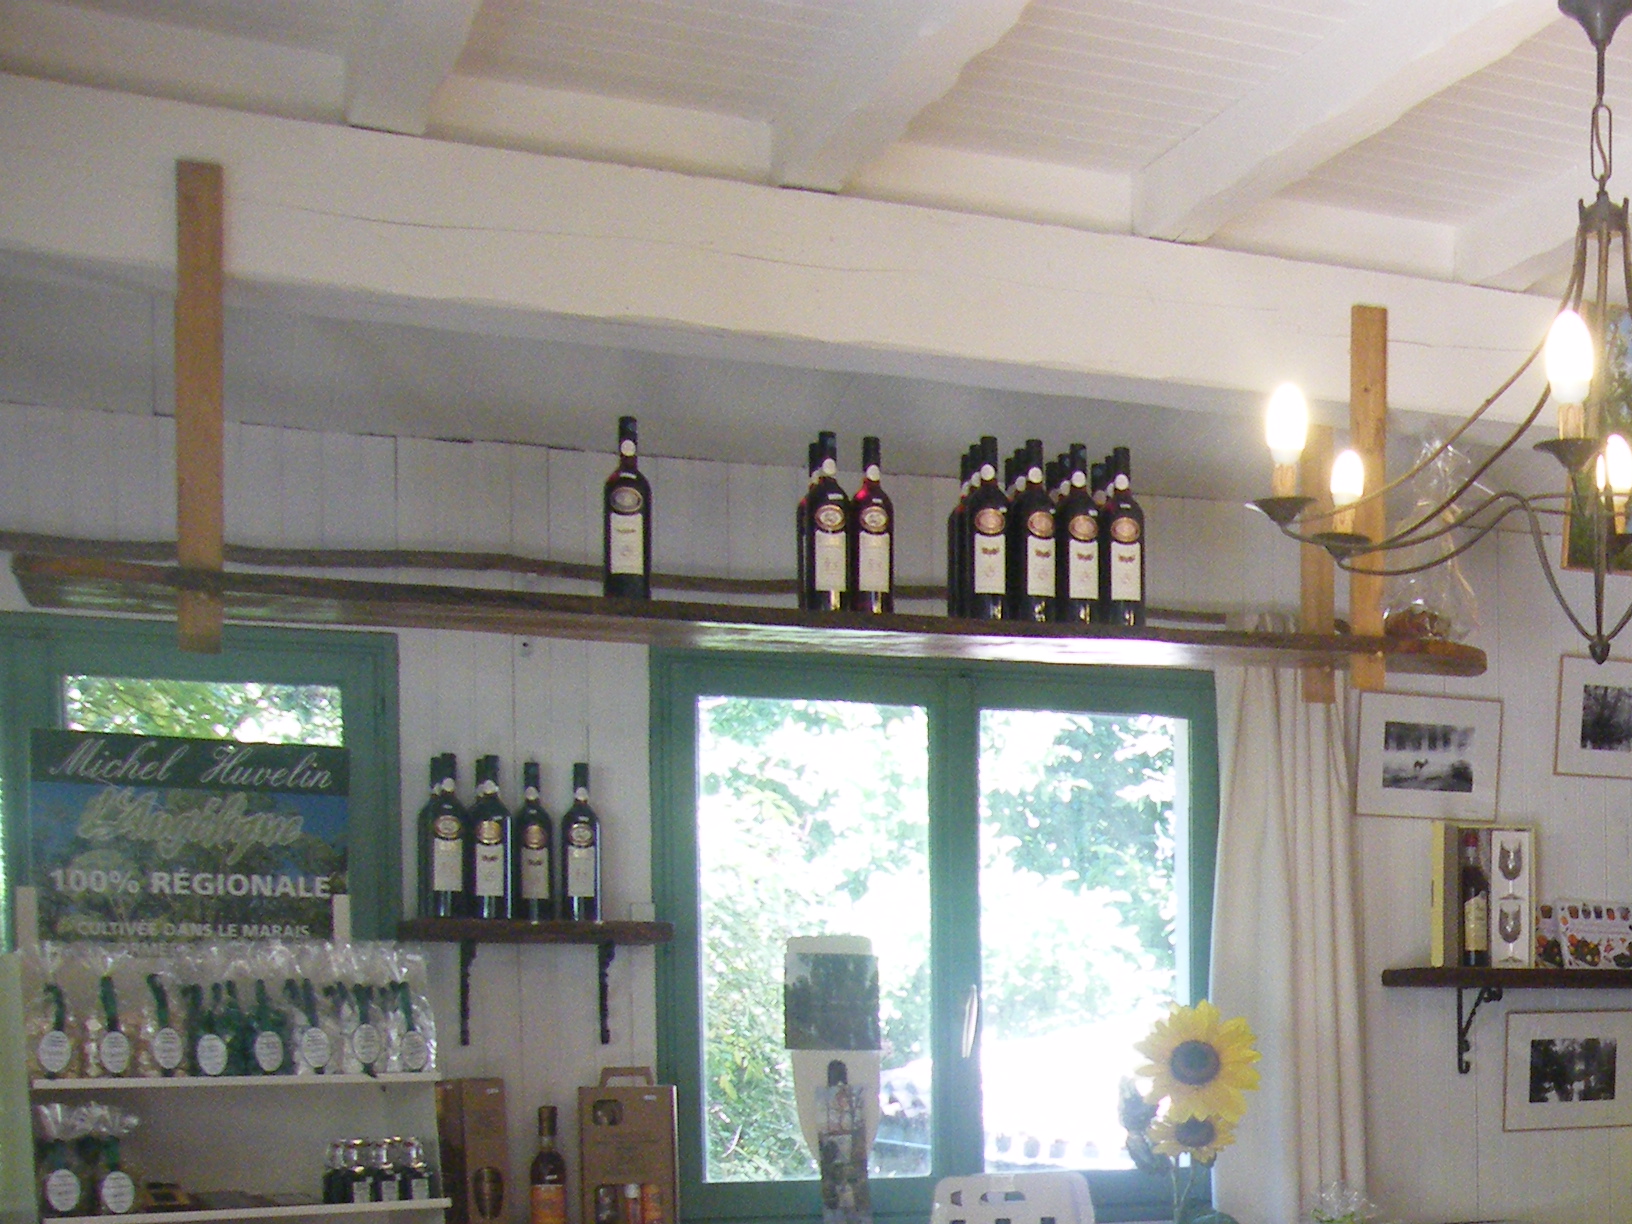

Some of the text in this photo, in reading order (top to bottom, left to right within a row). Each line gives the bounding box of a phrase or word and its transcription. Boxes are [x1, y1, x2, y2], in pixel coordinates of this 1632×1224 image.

[50, 738, 333, 789] Michel Huvelin
[49, 868, 332, 899] 100% RÉGIONALE
[162, 922, 213, 938] DANS
[217, 923, 238, 938] LE
[242, 923, 311, 939] MARAIS
